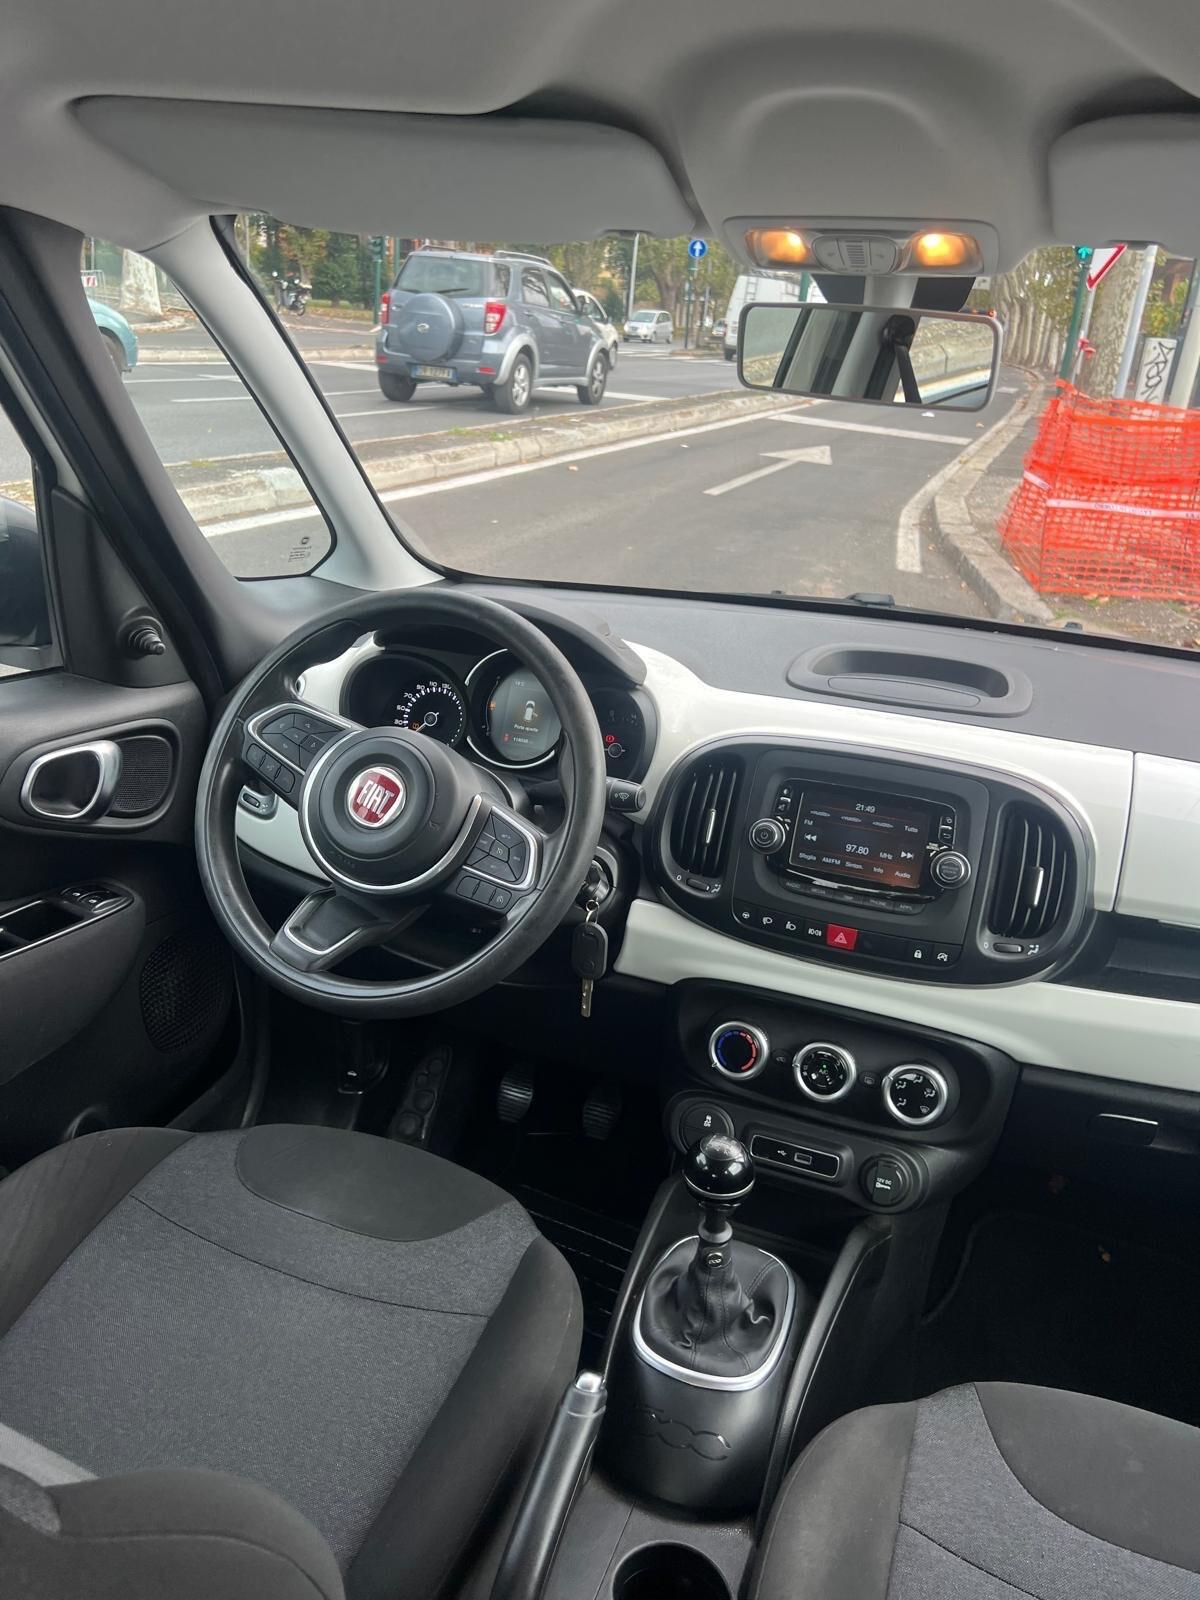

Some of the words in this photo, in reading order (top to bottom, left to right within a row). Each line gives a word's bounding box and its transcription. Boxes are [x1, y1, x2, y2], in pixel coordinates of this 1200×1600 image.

[356, 780, 396, 818] FIAT
[855, 803, 876, 813] 21:49
[845, 843, 870, 856] 97.80
[880, 851, 893, 861] MHz
[894, 871, 911, 879] Audio
